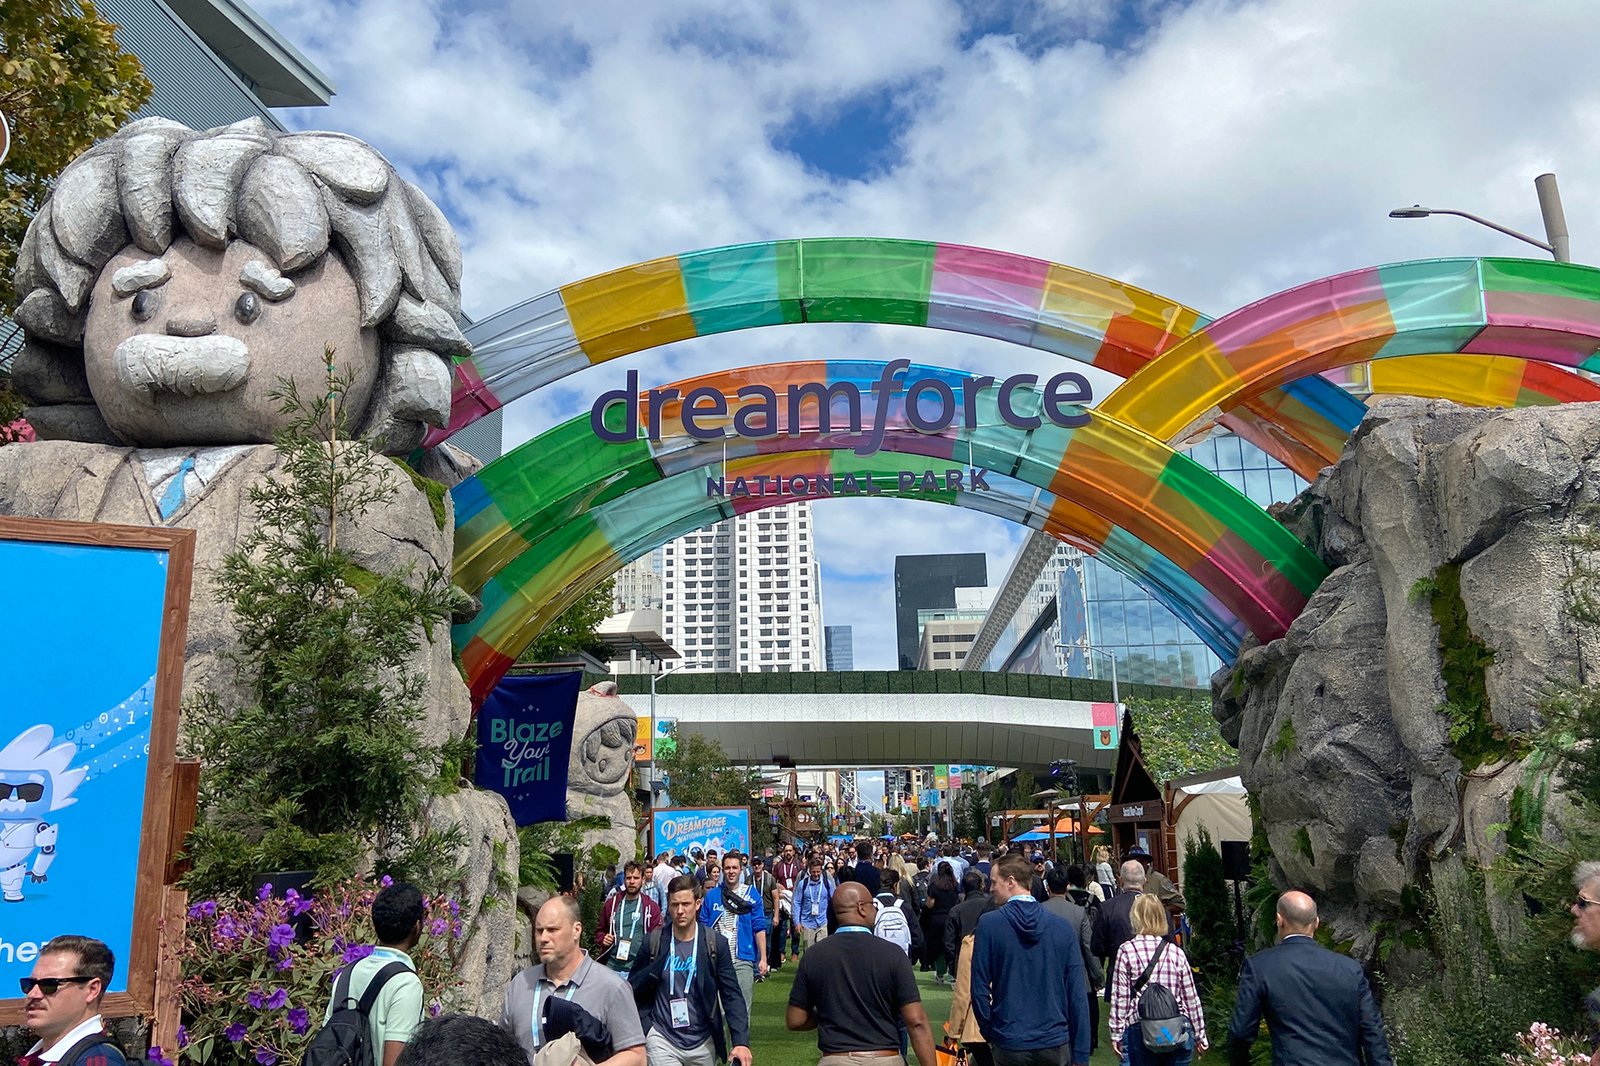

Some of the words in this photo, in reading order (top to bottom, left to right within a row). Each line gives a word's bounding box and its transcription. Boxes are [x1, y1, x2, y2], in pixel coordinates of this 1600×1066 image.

[590, 358, 1094, 458] dreamforce
[706, 471, 882, 497] NATIONAL
[898, 468, 990, 492] PARK
[491, 718, 563, 743] Blaze
[501, 757, 550, 787] Trail
[0, 937, 50, 963] he
